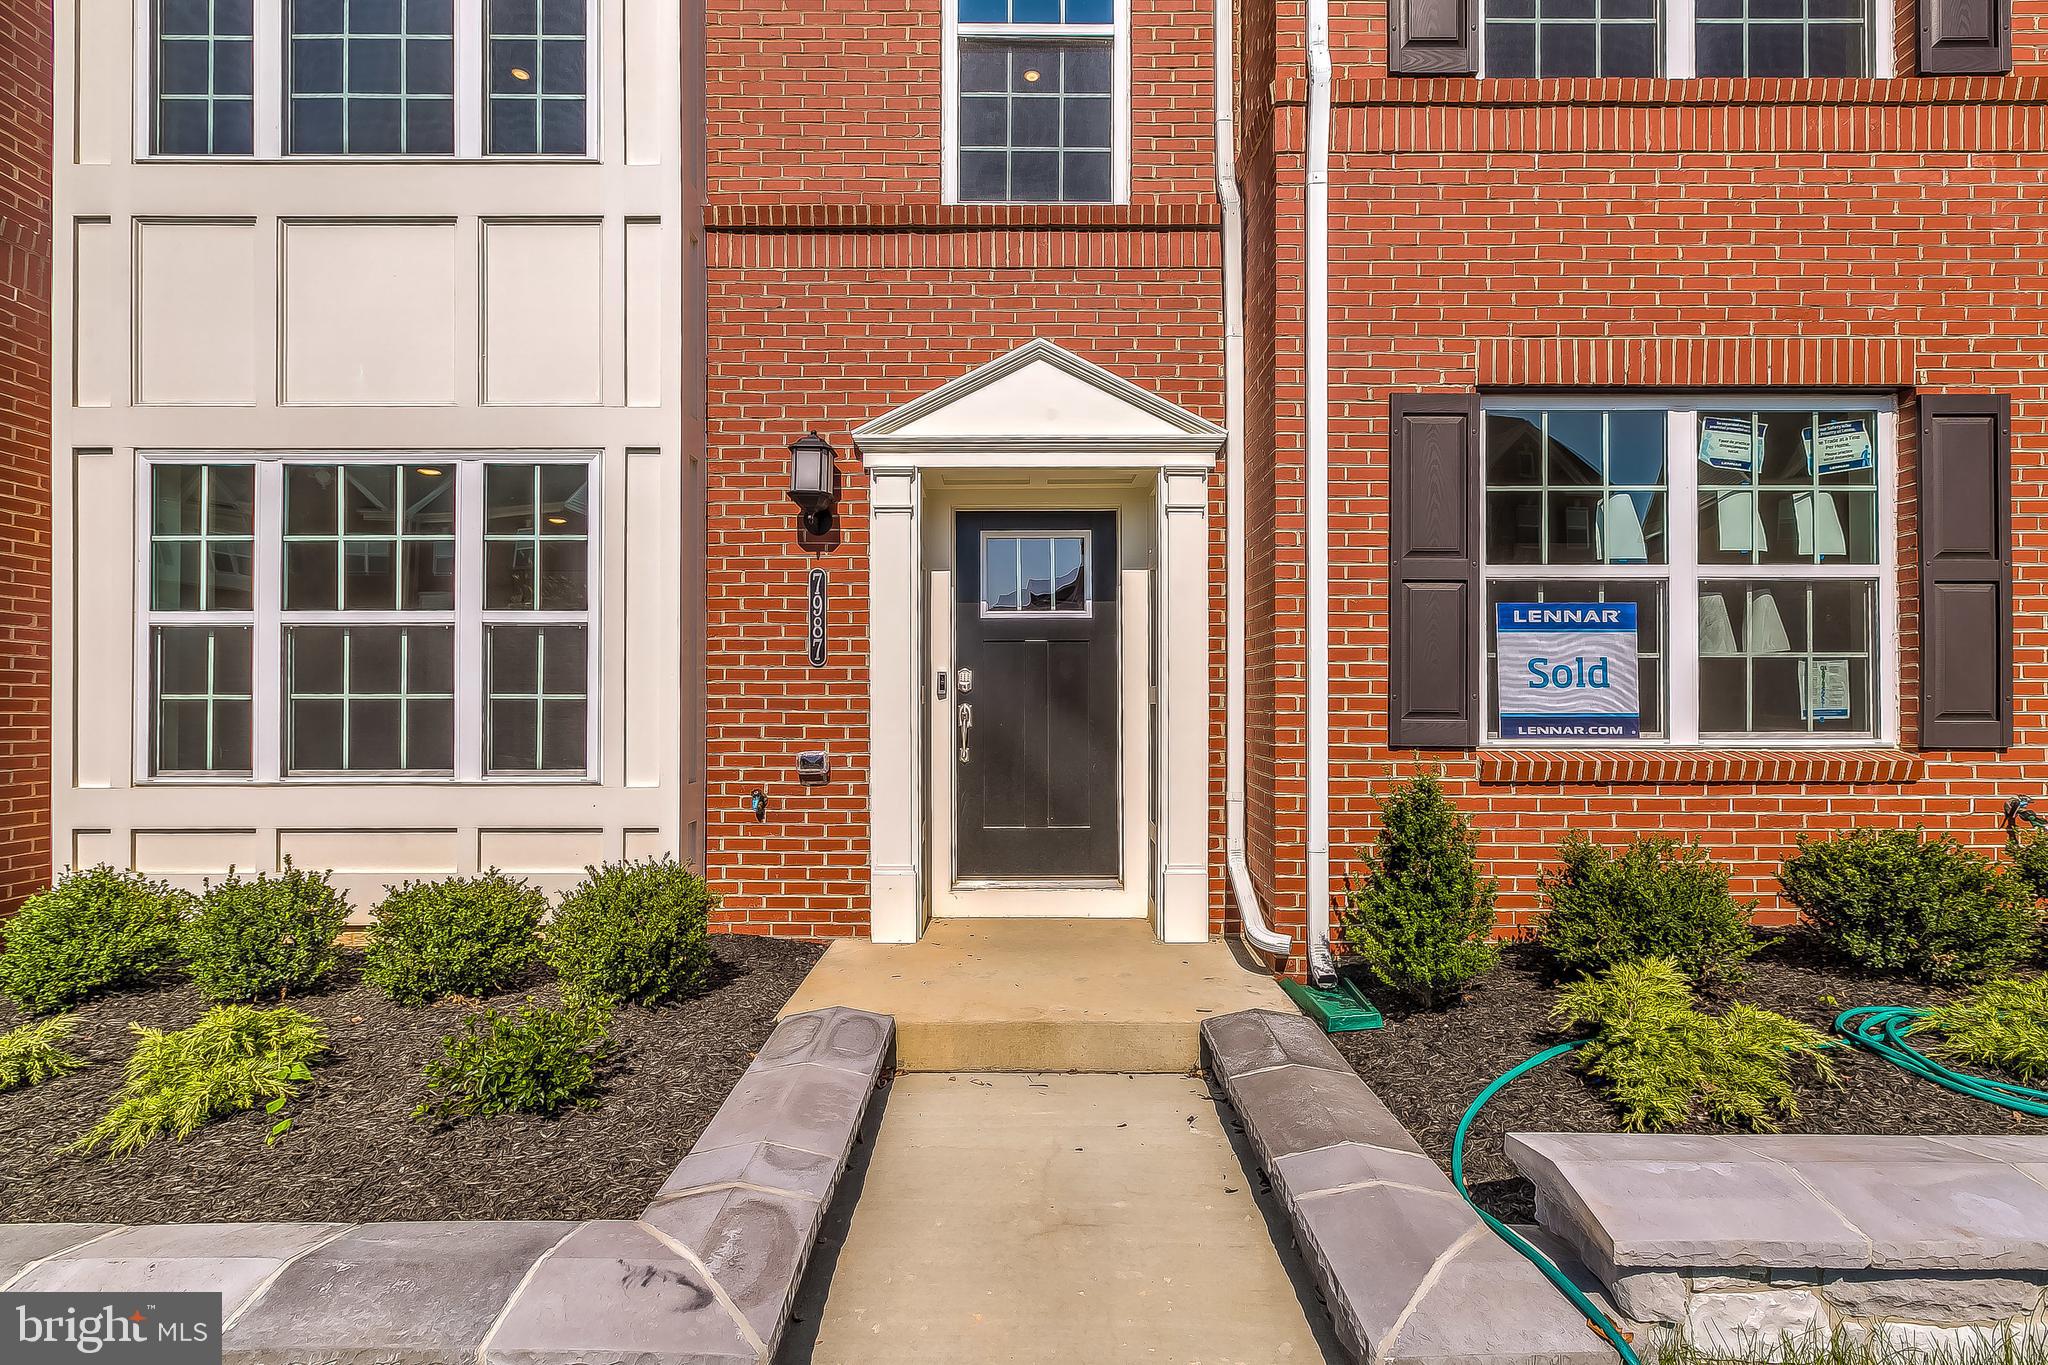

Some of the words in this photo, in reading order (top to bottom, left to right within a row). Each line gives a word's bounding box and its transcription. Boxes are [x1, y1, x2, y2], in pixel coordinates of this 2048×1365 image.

[812, 572, 823, 661] 7987
[1513, 610, 1619, 623] LENNAR
[1527, 656, 1611, 689] Sold
[1518, 726, 1624, 736] LENNAR.COM
